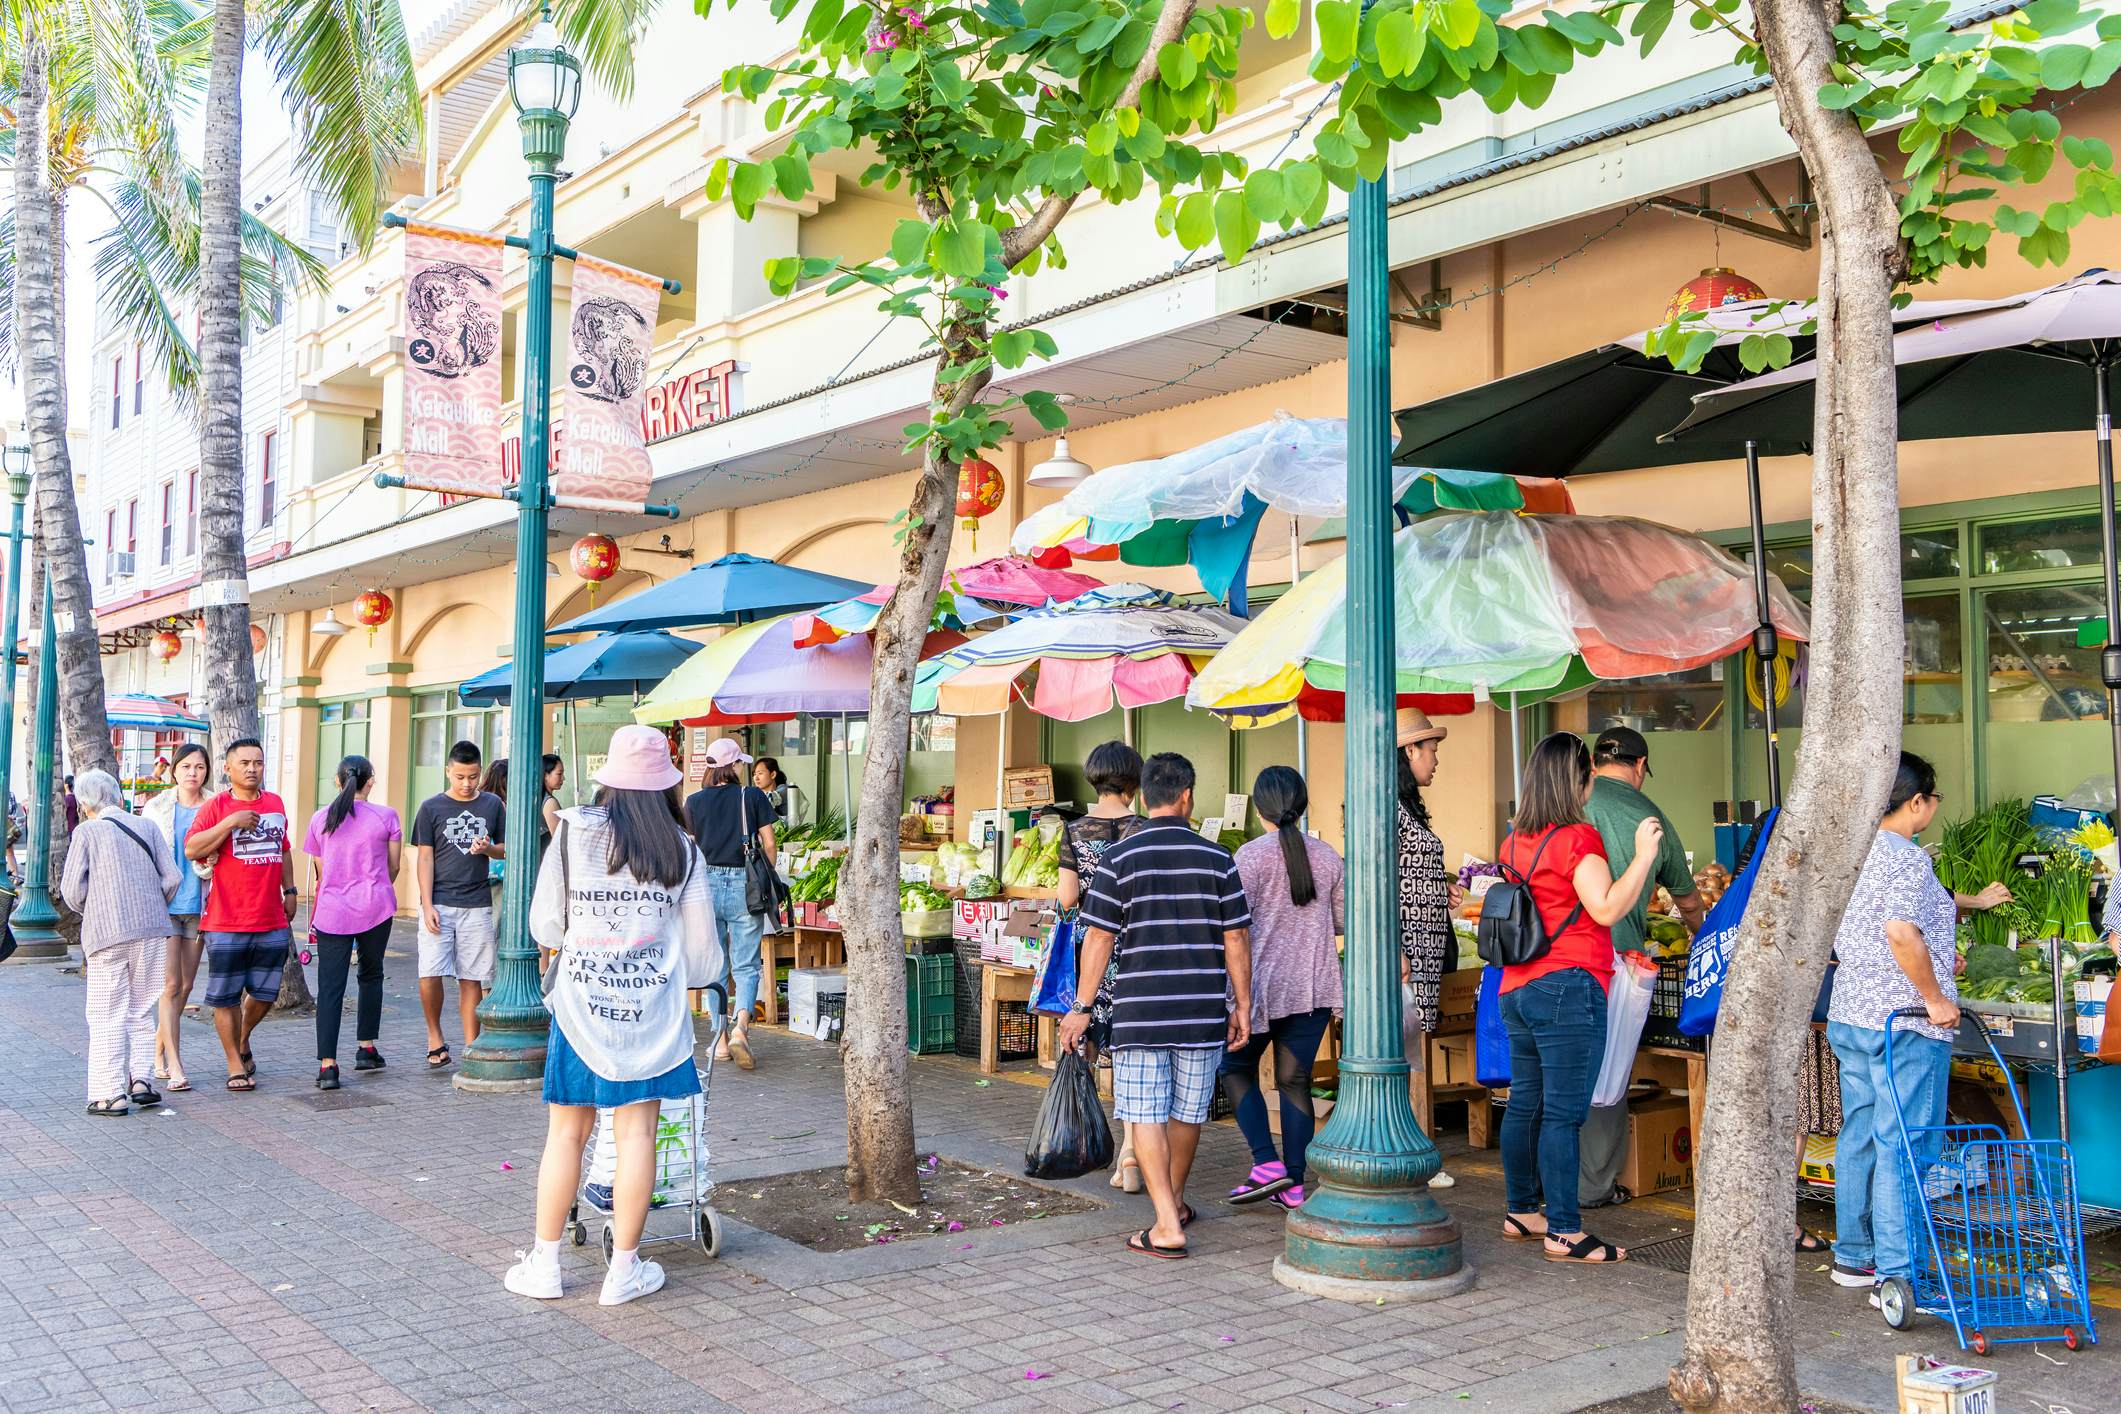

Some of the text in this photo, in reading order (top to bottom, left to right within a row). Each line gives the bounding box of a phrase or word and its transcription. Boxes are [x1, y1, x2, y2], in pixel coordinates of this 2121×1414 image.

[414, 344, 432, 360] 友
[574, 369, 593, 384] 友
[411, 388, 495, 425] Kekaulike
[641, 359, 736, 443] RKET
[412, 424, 449, 454] Mall
[567, 445, 603, 476] Mall
[243, 856, 268, 865] TEAM
[572, 905, 663, 918] GUCCI
[625, 947, 664, 960] KLEIN
[568, 956, 660, 975] PRADA
[598, 973, 669, 989] SIMONS
[587, 1001, 643, 1022] YEEZY
[1654, 1170, 1681, 1189] Aloun
